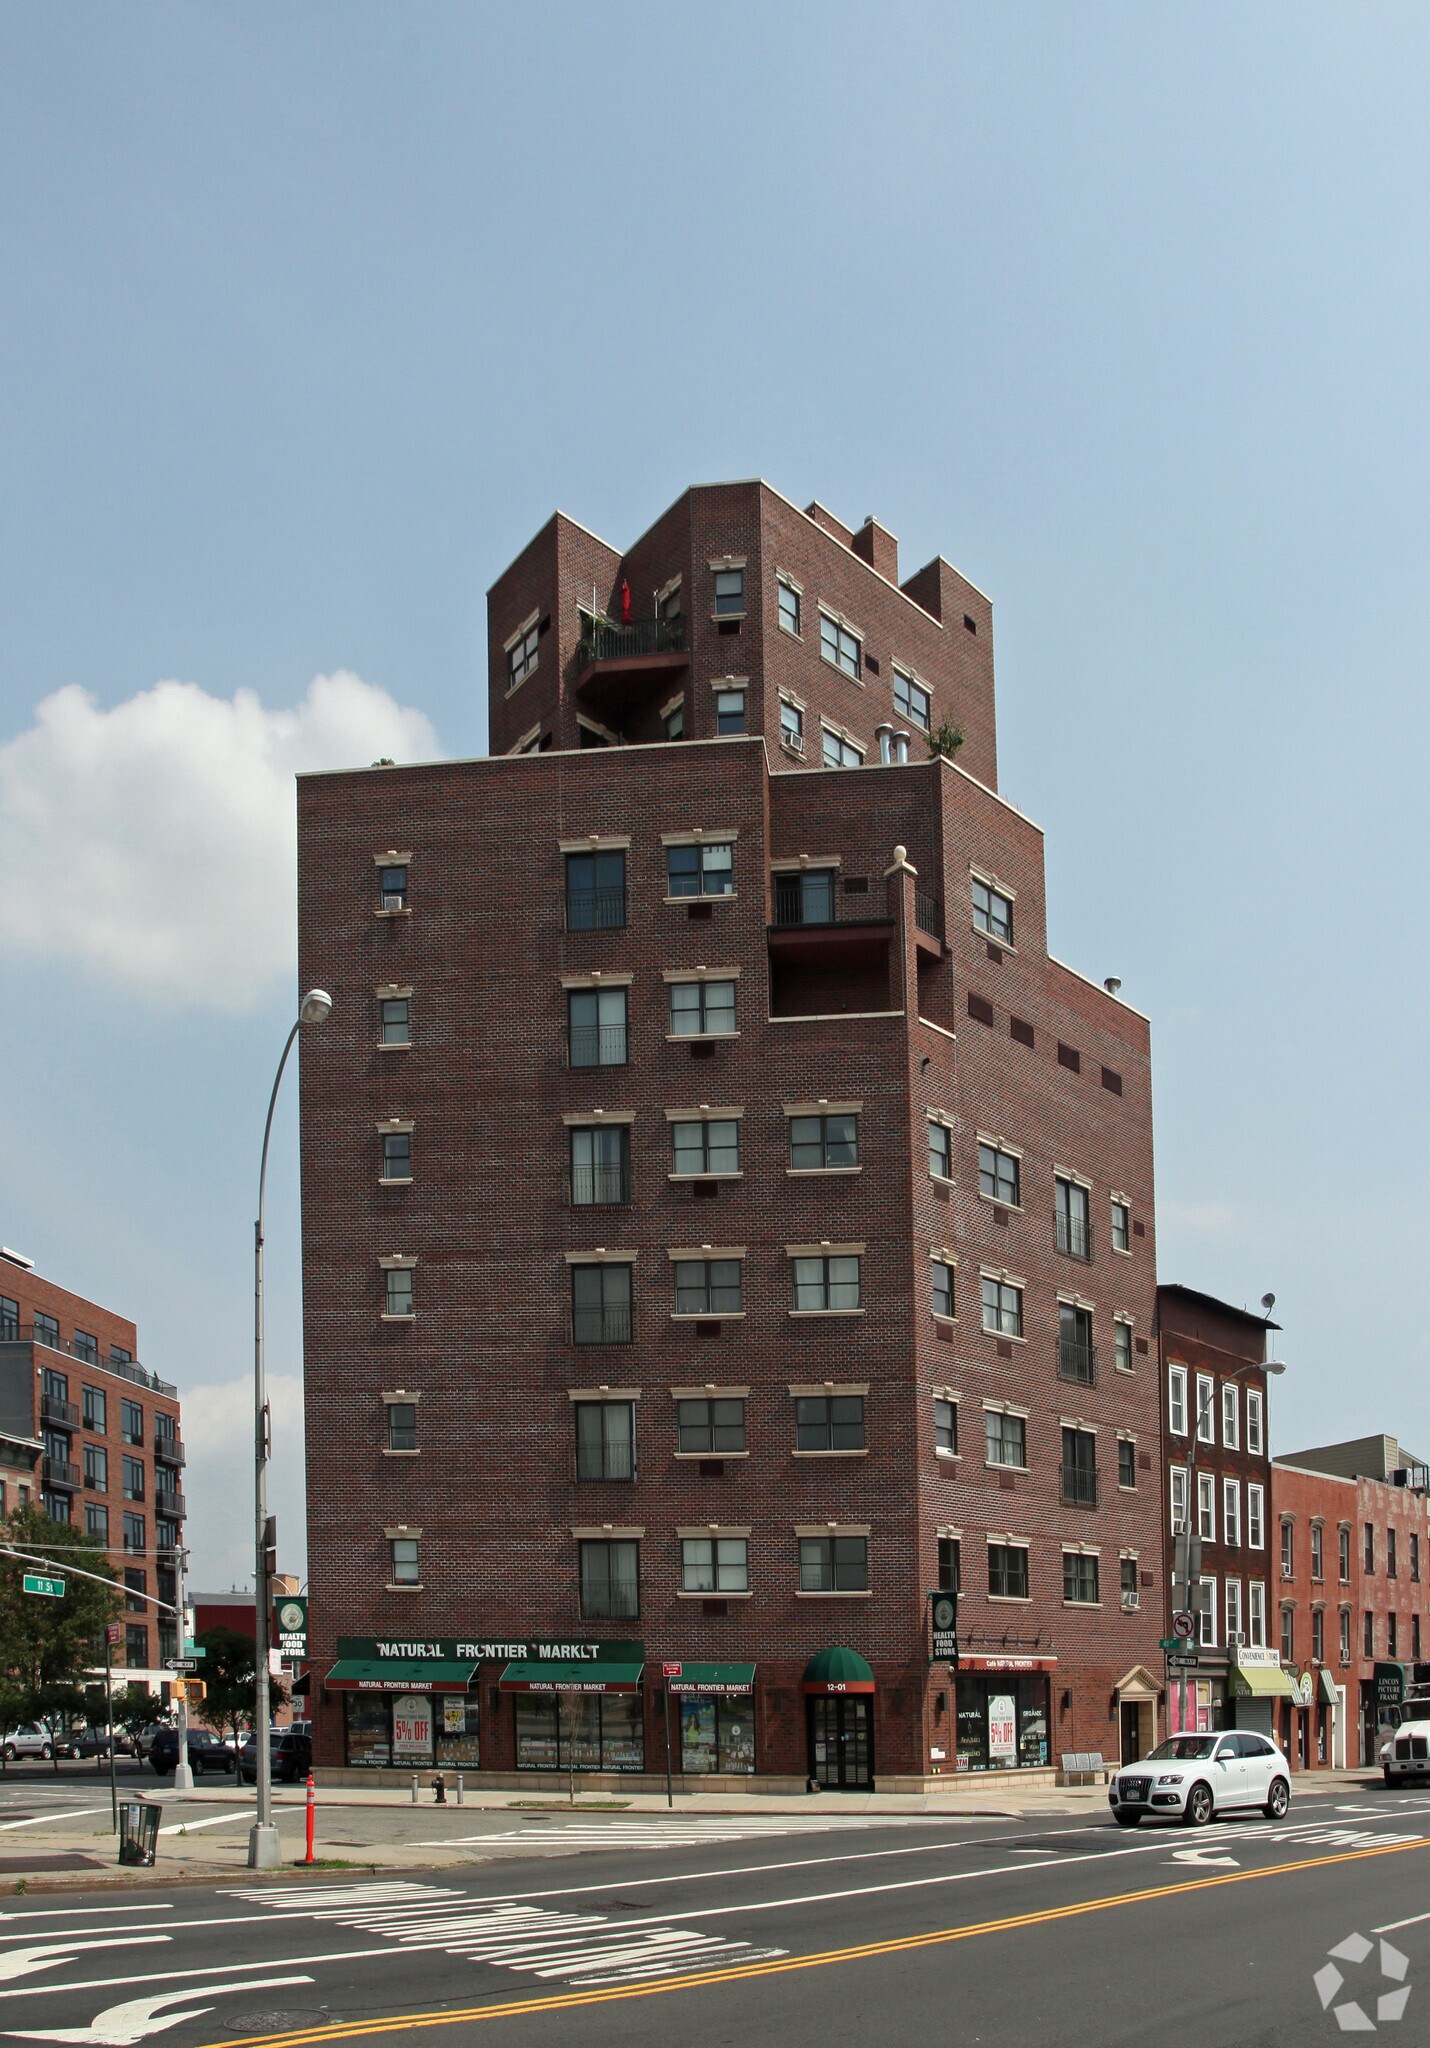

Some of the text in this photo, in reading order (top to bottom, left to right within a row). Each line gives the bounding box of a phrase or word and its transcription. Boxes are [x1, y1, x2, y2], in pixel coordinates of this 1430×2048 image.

[38, 1581, 54, 1592] 11 St
[933, 1631, 955, 1639] HEALTH
[380, 1643, 444, 1657] NATURAL
[456, 1644, 527, 1658] FRONTIER
[396, 1721, 428, 1741] 5% OFF
[1004, 1722, 1012, 1742] OFF
[1240, 1829, 1424, 1848] ONLY
[215, 1881, 468, 1908] ONLY
[313, 1902, 608, 1942] ONLY
[445, 1926, 790, 1985] ONLY
